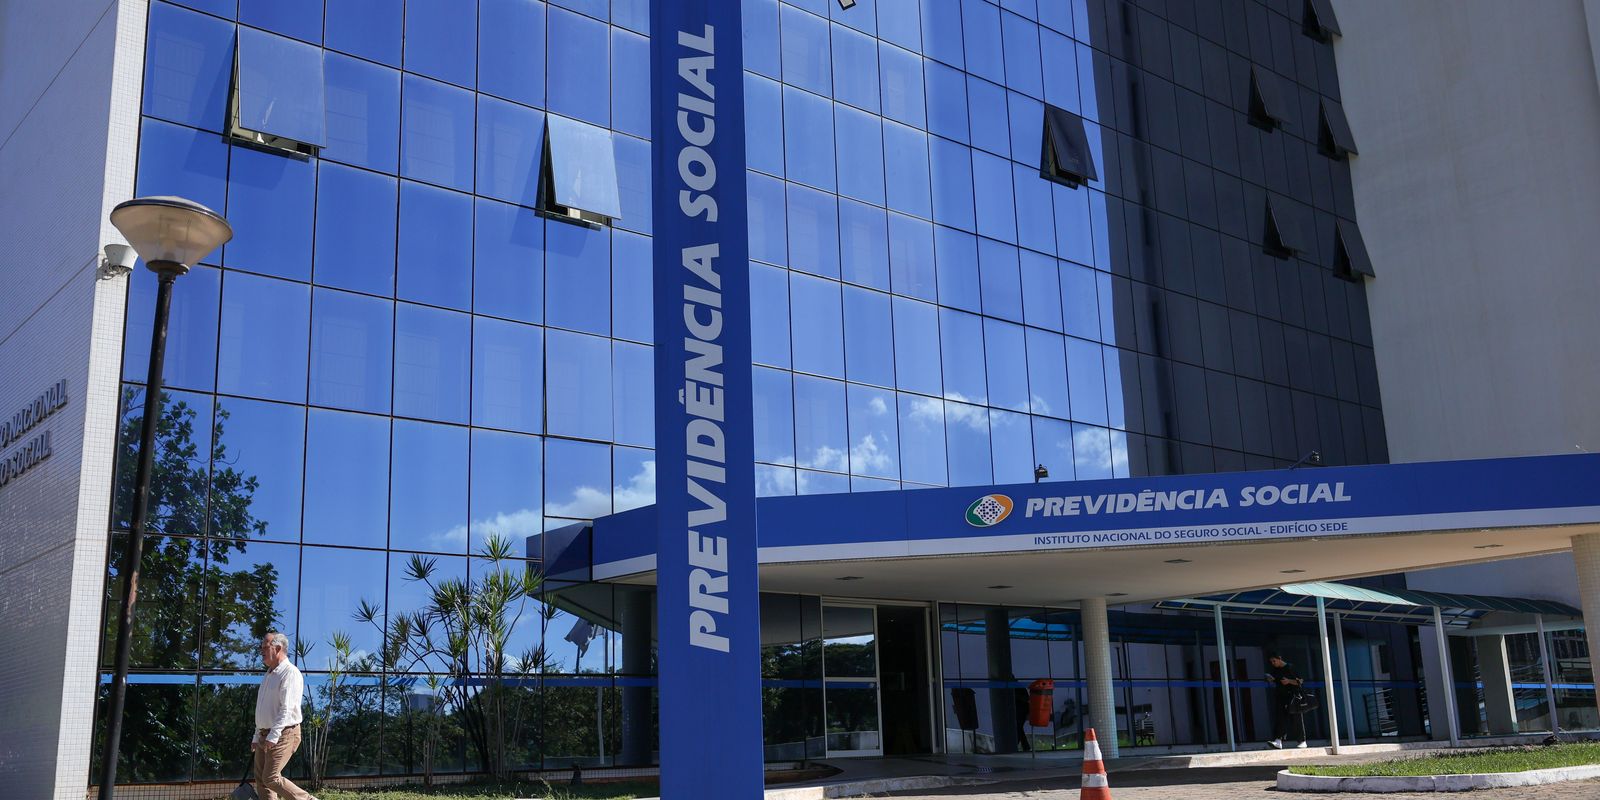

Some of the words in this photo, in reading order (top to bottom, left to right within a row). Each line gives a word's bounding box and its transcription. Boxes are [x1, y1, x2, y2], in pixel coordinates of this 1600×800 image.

[677, 24, 719, 223] SOCIAL
[9, 379, 68, 443] NACIONAL
[10, 431, 52, 478] SOCIAL
[678, 243, 730, 653] PREVIDÊNCIA
[1025, 488, 1229, 518] PREVIDÊNCIA
[1239, 482, 1351, 507] SOCIAL
[1034, 534, 1091, 545] INSTITUTO
[1093, 531, 1151, 543] NACIONAL
[1154, 530, 1172, 540] DO
[1174, 528, 1220, 539] SEGURO
[1221, 526, 1262, 537] SOCIAL
[1269, 522, 1318, 534] EDIFÍCIO
[1320, 522, 1348, 532] SEDE
